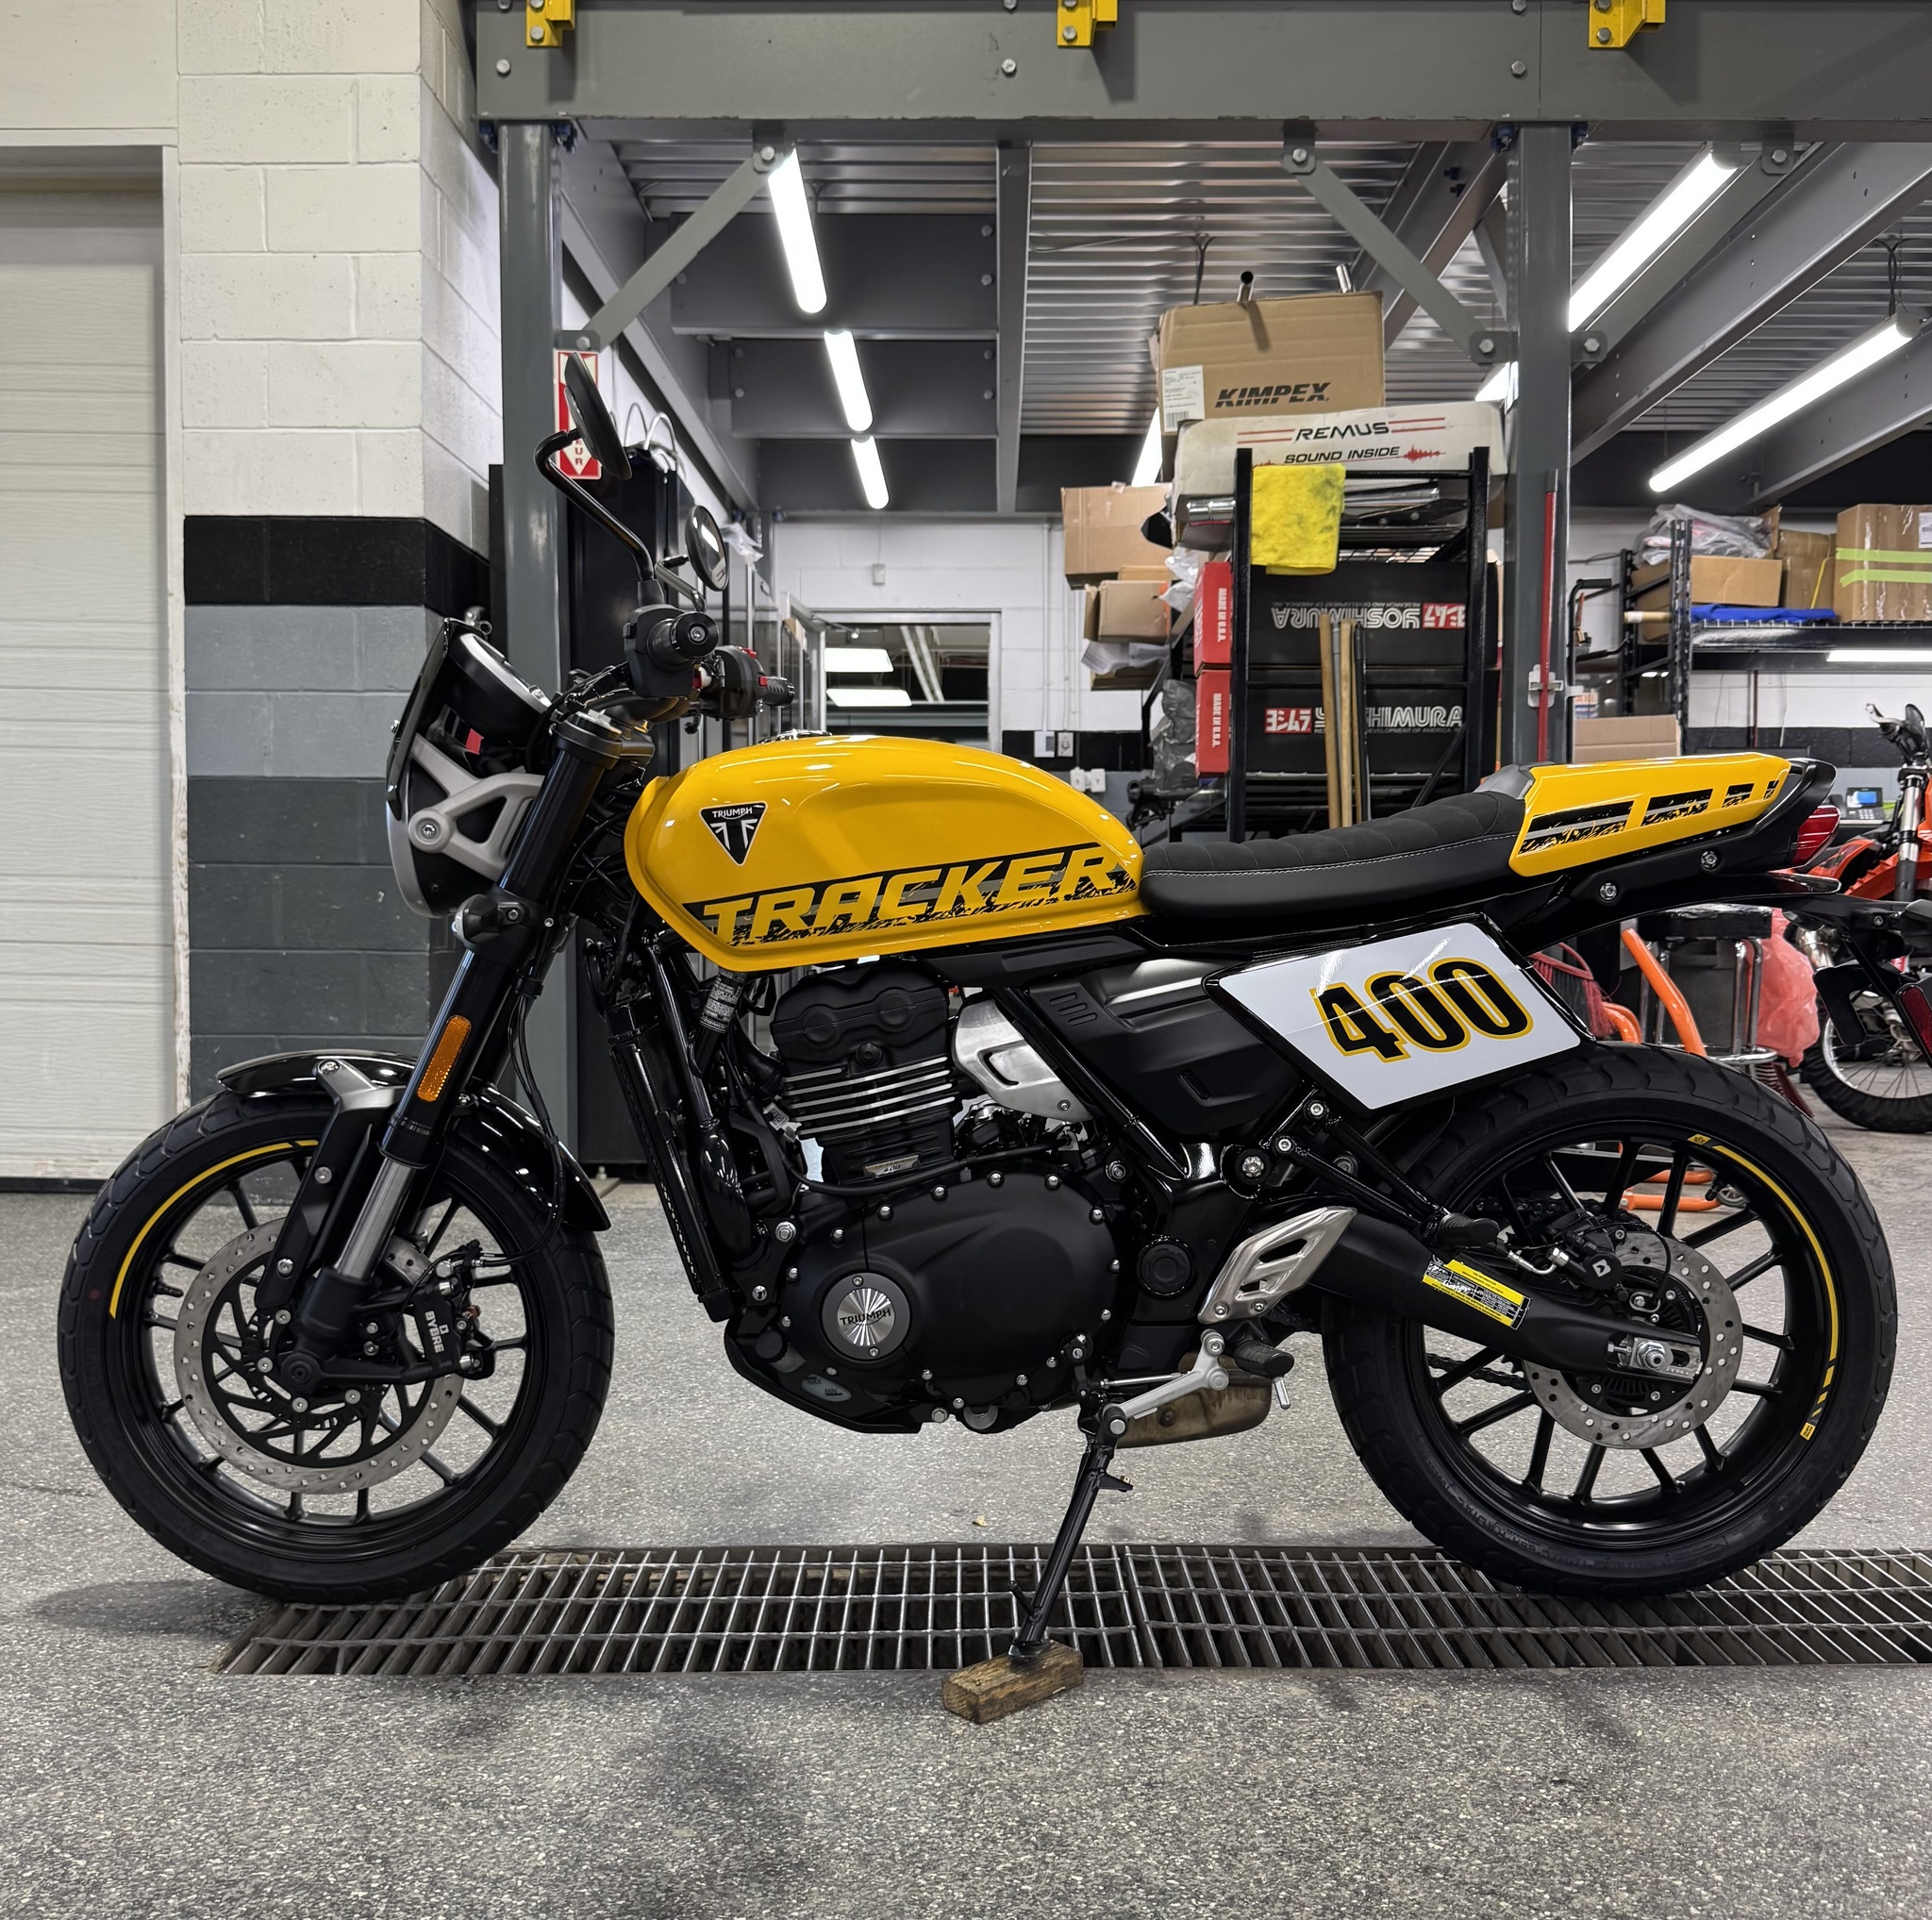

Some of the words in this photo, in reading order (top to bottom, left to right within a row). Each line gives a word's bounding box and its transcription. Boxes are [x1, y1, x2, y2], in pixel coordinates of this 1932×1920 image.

[1215, 382, 1330, 408] KIMPEX
[1293, 422, 1390, 444] REMUS
[1284, 451, 1343, 464] SOUND
[1347, 446, 1400, 459] INSIDE
[1218, 588, 1227, 610] MADE
[1218, 611, 1227, 620] IN
[1213, 693, 1222, 716] MADE
[1213, 716, 1222, 726] IN
[1266, 710, 1311, 731] ヨシムラ
[711, 807, 754, 819] TRIUMPH
[704, 849, 1121, 941] TRACKER
[1309, 957, 1533, 1063] 400
[840, 1308, 891, 1326] TRIUMPH
[425, 1311, 444, 1354] BYBRE
